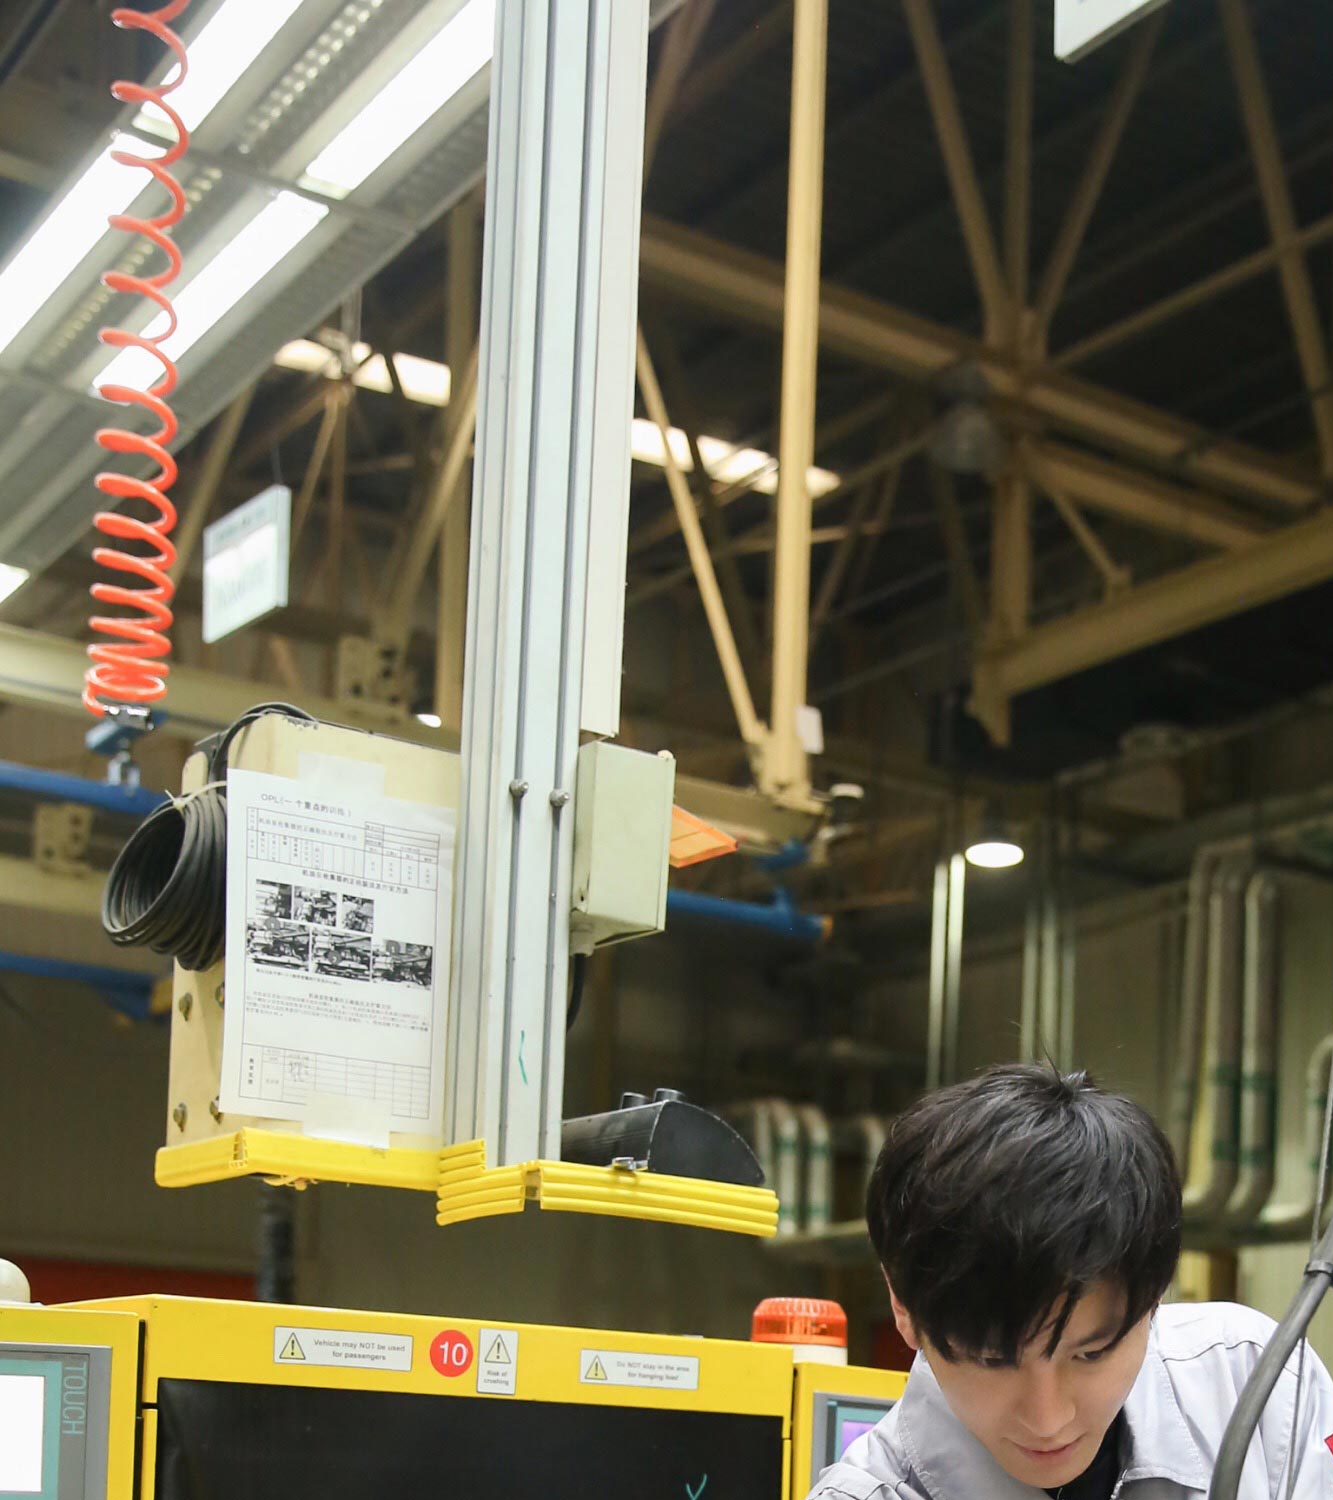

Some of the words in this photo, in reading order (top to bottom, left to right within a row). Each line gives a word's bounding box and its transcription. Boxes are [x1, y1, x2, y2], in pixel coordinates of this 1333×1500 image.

[313, 1338, 340, 1347] Vehicle
[342, 1342, 357, 1350] may
[359, 1342, 375, 1350] NOT
[377, 1343, 386, 1351] be
[439, 1340, 468, 1367] 10
[332, 1350, 343, 1358] for
[344, 1352, 387, 1361] passengers
[62, 1360, 87, 1436] TOUCH
